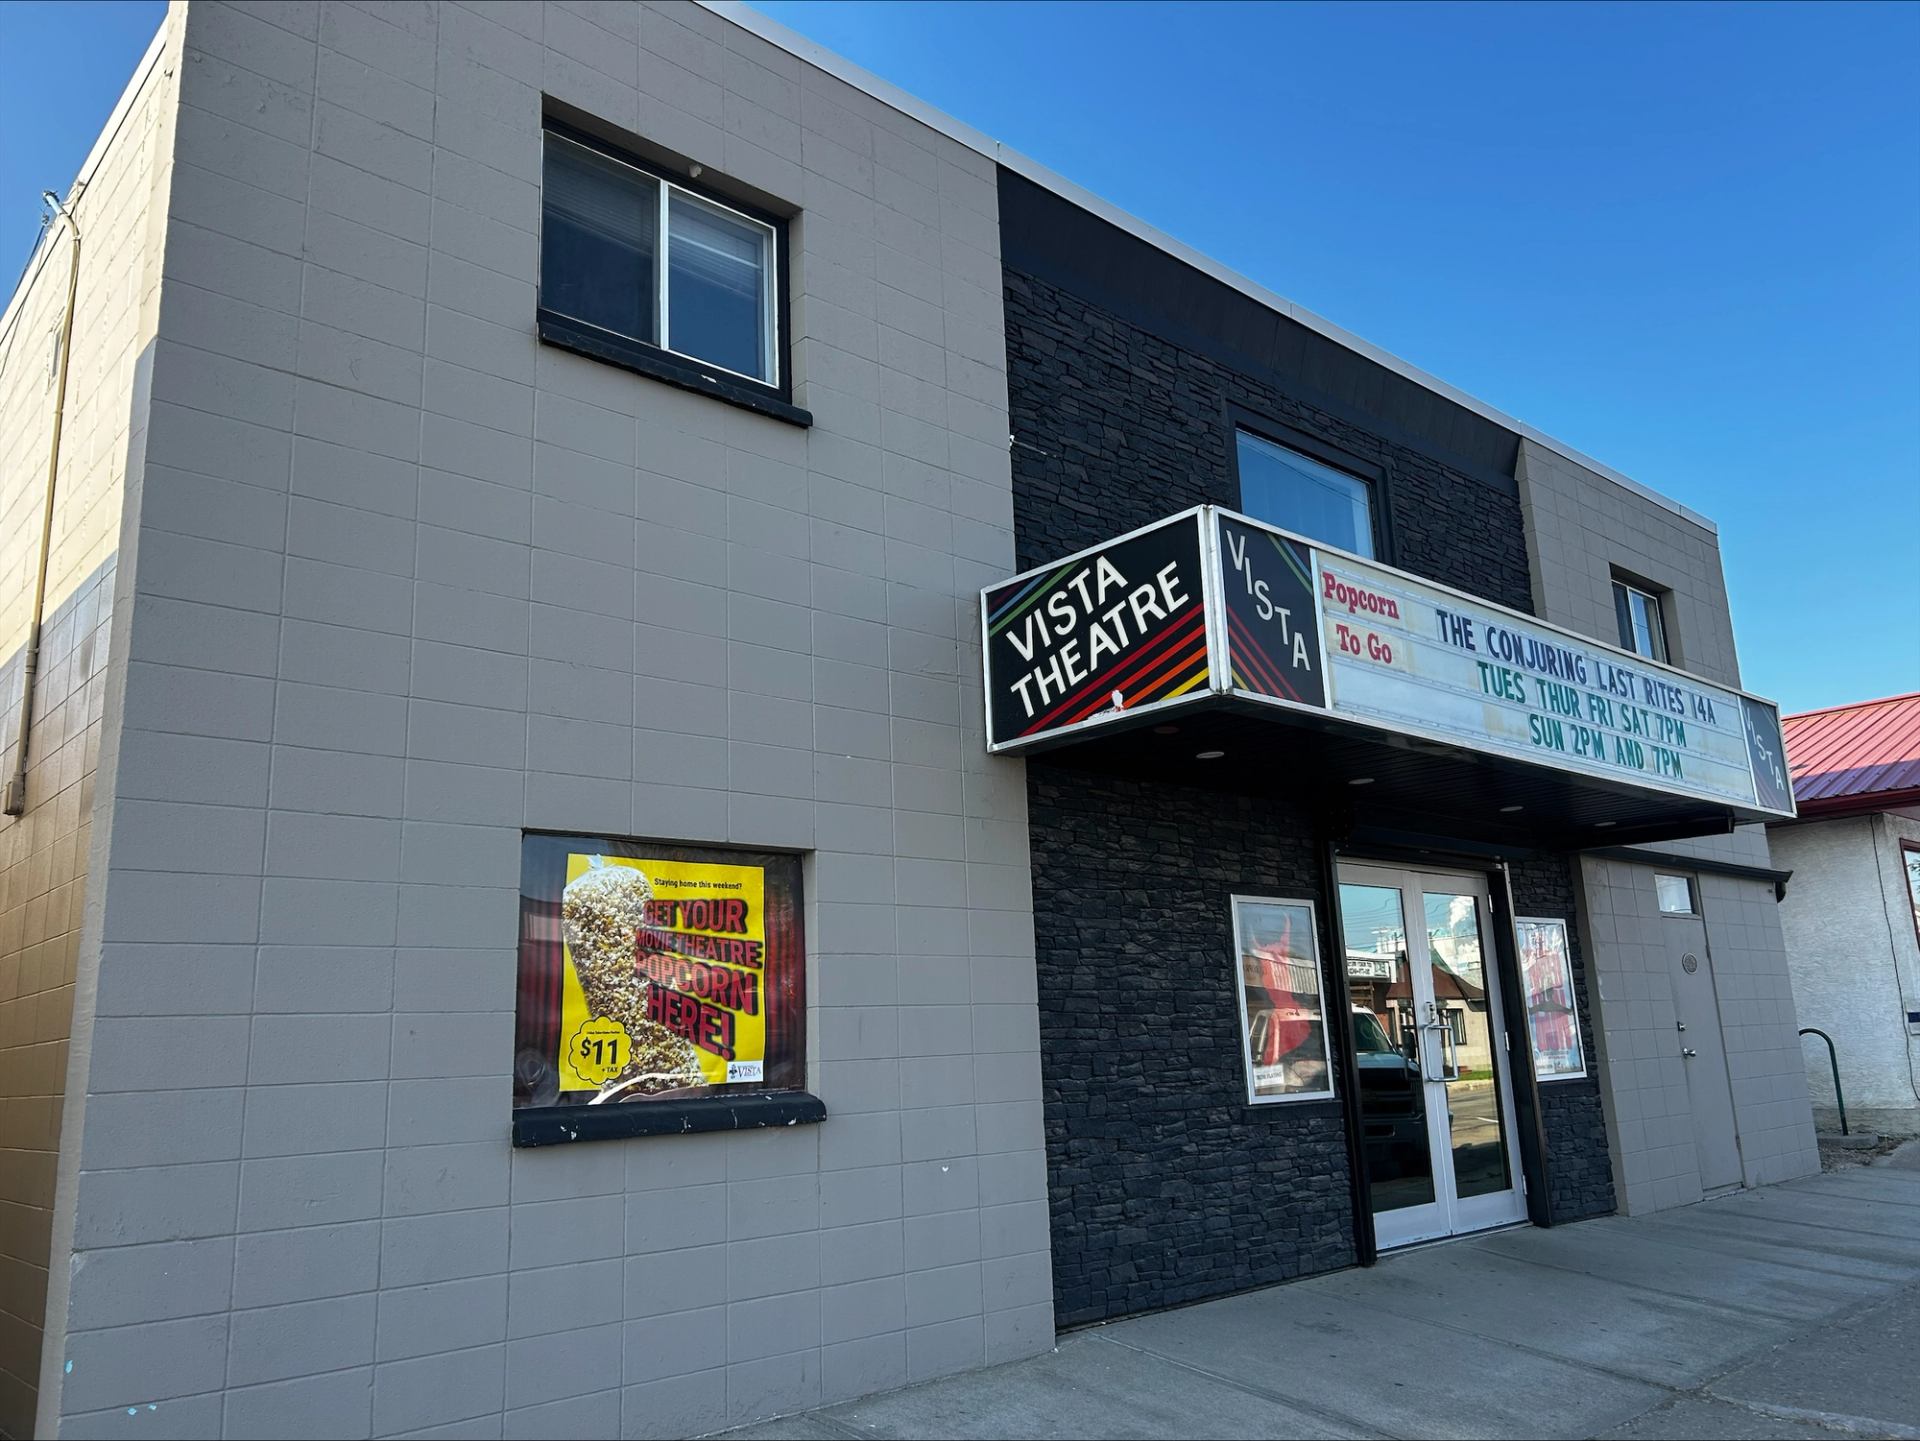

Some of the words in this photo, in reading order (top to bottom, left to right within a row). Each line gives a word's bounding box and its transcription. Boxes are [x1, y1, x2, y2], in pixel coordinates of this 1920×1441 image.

[1006, 555, 1128, 662] VISTA
[1226, 529, 1311, 671] VISTA
[1322, 571, 1400, 620] Popcorn
[1010, 560, 1189, 718] THEATRE
[1336, 623, 1360, 655] To
[1367, 633, 1392, 664] Go
[1436, 609, 1476, 651] THE
[1487, 626, 1587, 685] CONJURING
[1596, 661, 1636, 699] LAST
[1643, 677, 1685, 715] RITES
[1692, 694, 1716, 724] 14A
[1477, 661, 1526, 704] TUES
[1536, 678, 1582, 718] THUR
[1588, 693, 1615, 727] FRI
[1622, 704, 1650, 737] SAT
[1655, 714, 1688, 747] 7PM
[1529, 713, 1565, 751] SUN
[1571, 726, 1605, 760] 2PM
[1616, 736, 1644, 770] AND
[1654, 746, 1683, 779] 7PM
[1742, 707, 1784, 790] VISTA
[644, 900, 676, 927] GET
[678, 900, 746, 933] YOUR
[654, 878, 678, 888] Staying
[680, 880, 697, 888] home
[713, 881, 742, 889] weekend?
[637, 928, 674, 953] MOVIE
[676, 933, 762, 969] THEATRE
[636, 949, 759, 1015] POPCORN
[580, 1037, 617, 1065] $11
[646, 984, 735, 1061] HERE!
